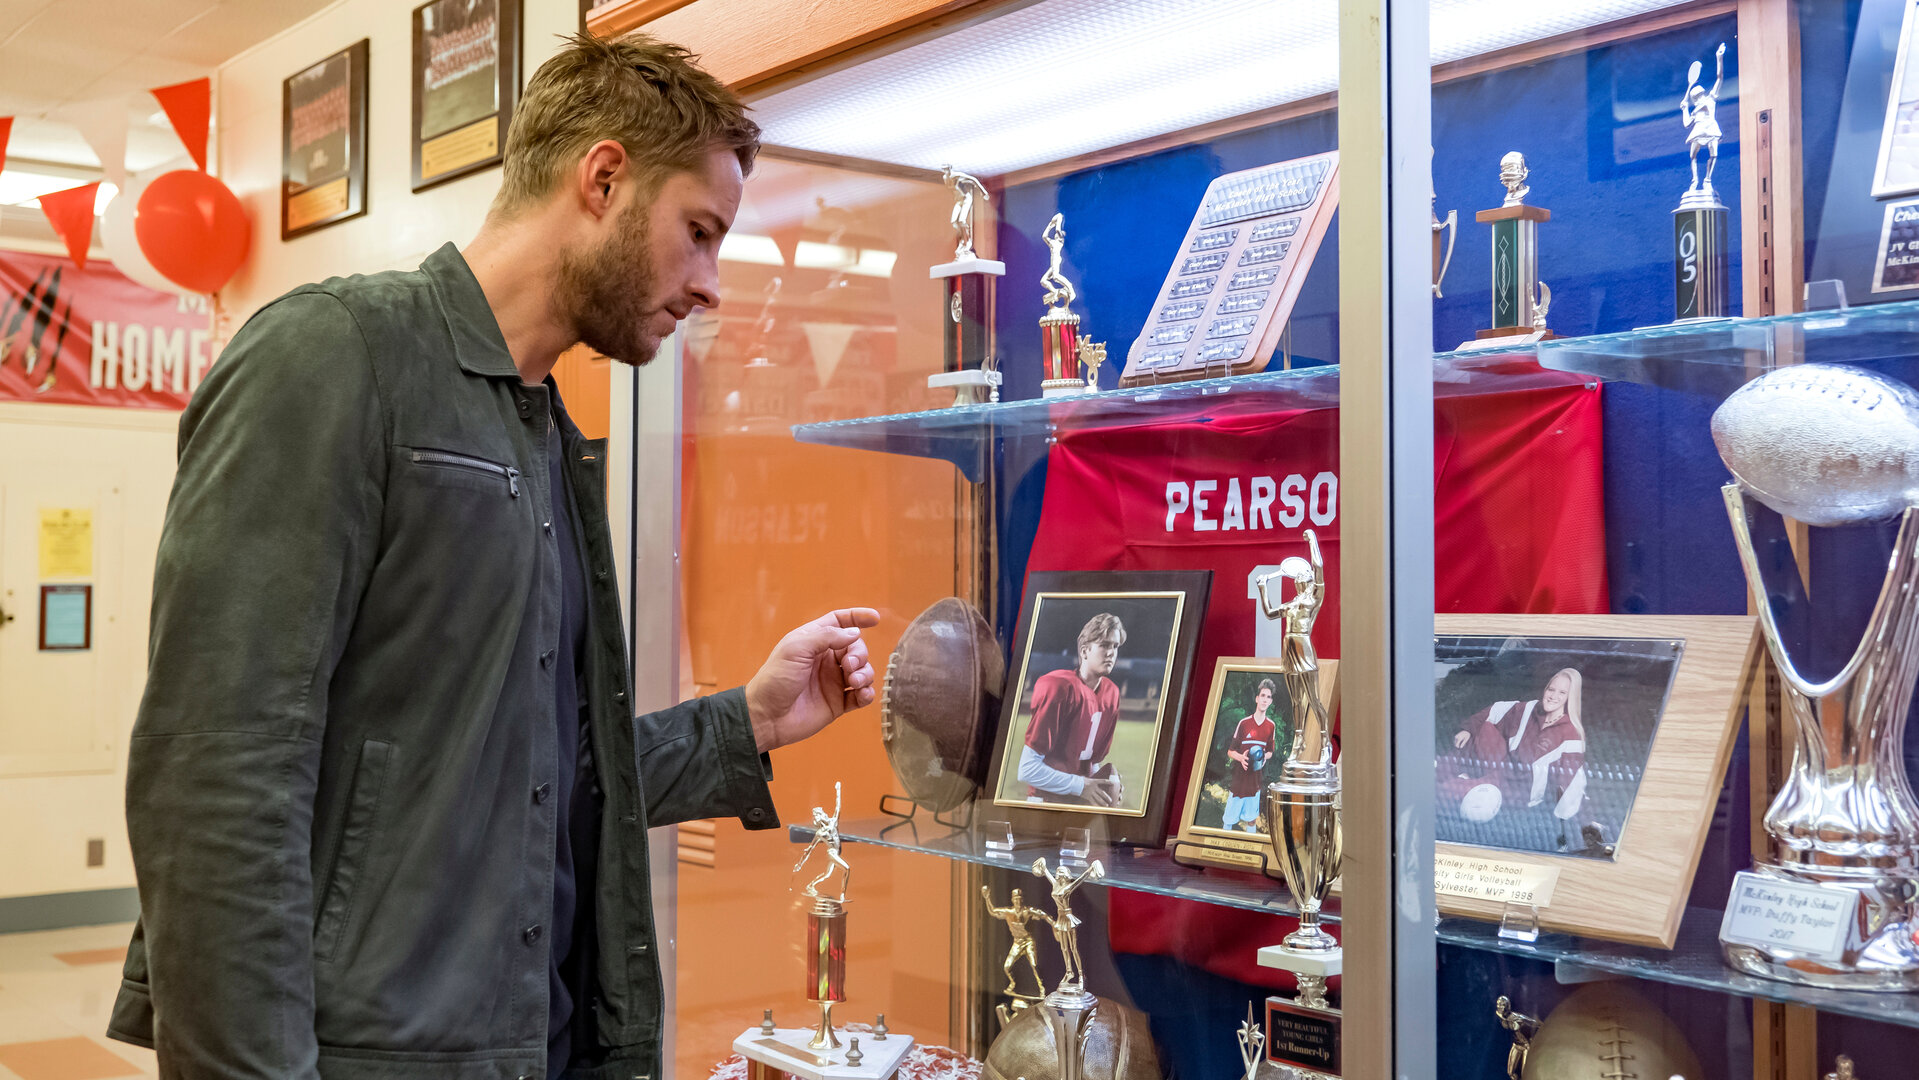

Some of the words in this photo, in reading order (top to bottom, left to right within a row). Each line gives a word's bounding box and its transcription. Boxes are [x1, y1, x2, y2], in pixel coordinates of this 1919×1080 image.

[1282, 177, 1303, 187] Year
[1278, 186, 1307, 198] School
[91, 320, 222, 394] HOME
[1165, 471, 1338, 532] PEARSO
[1079, 712, 1103, 760] 1
[1469, 862, 1488, 872] High
[1493, 865, 1523, 875] School
[1455, 871, 1474, 881] Girls
[1480, 874, 1522, 887] Volleyball
[1485, 887, 1505, 897] MVP
[1511, 891, 1534, 901] 1998
[1769, 928, 1795, 940] 2017
[1277, 1018, 1294, 1029] VERY
[1288, 1041, 1330, 1061] Runner-Up
